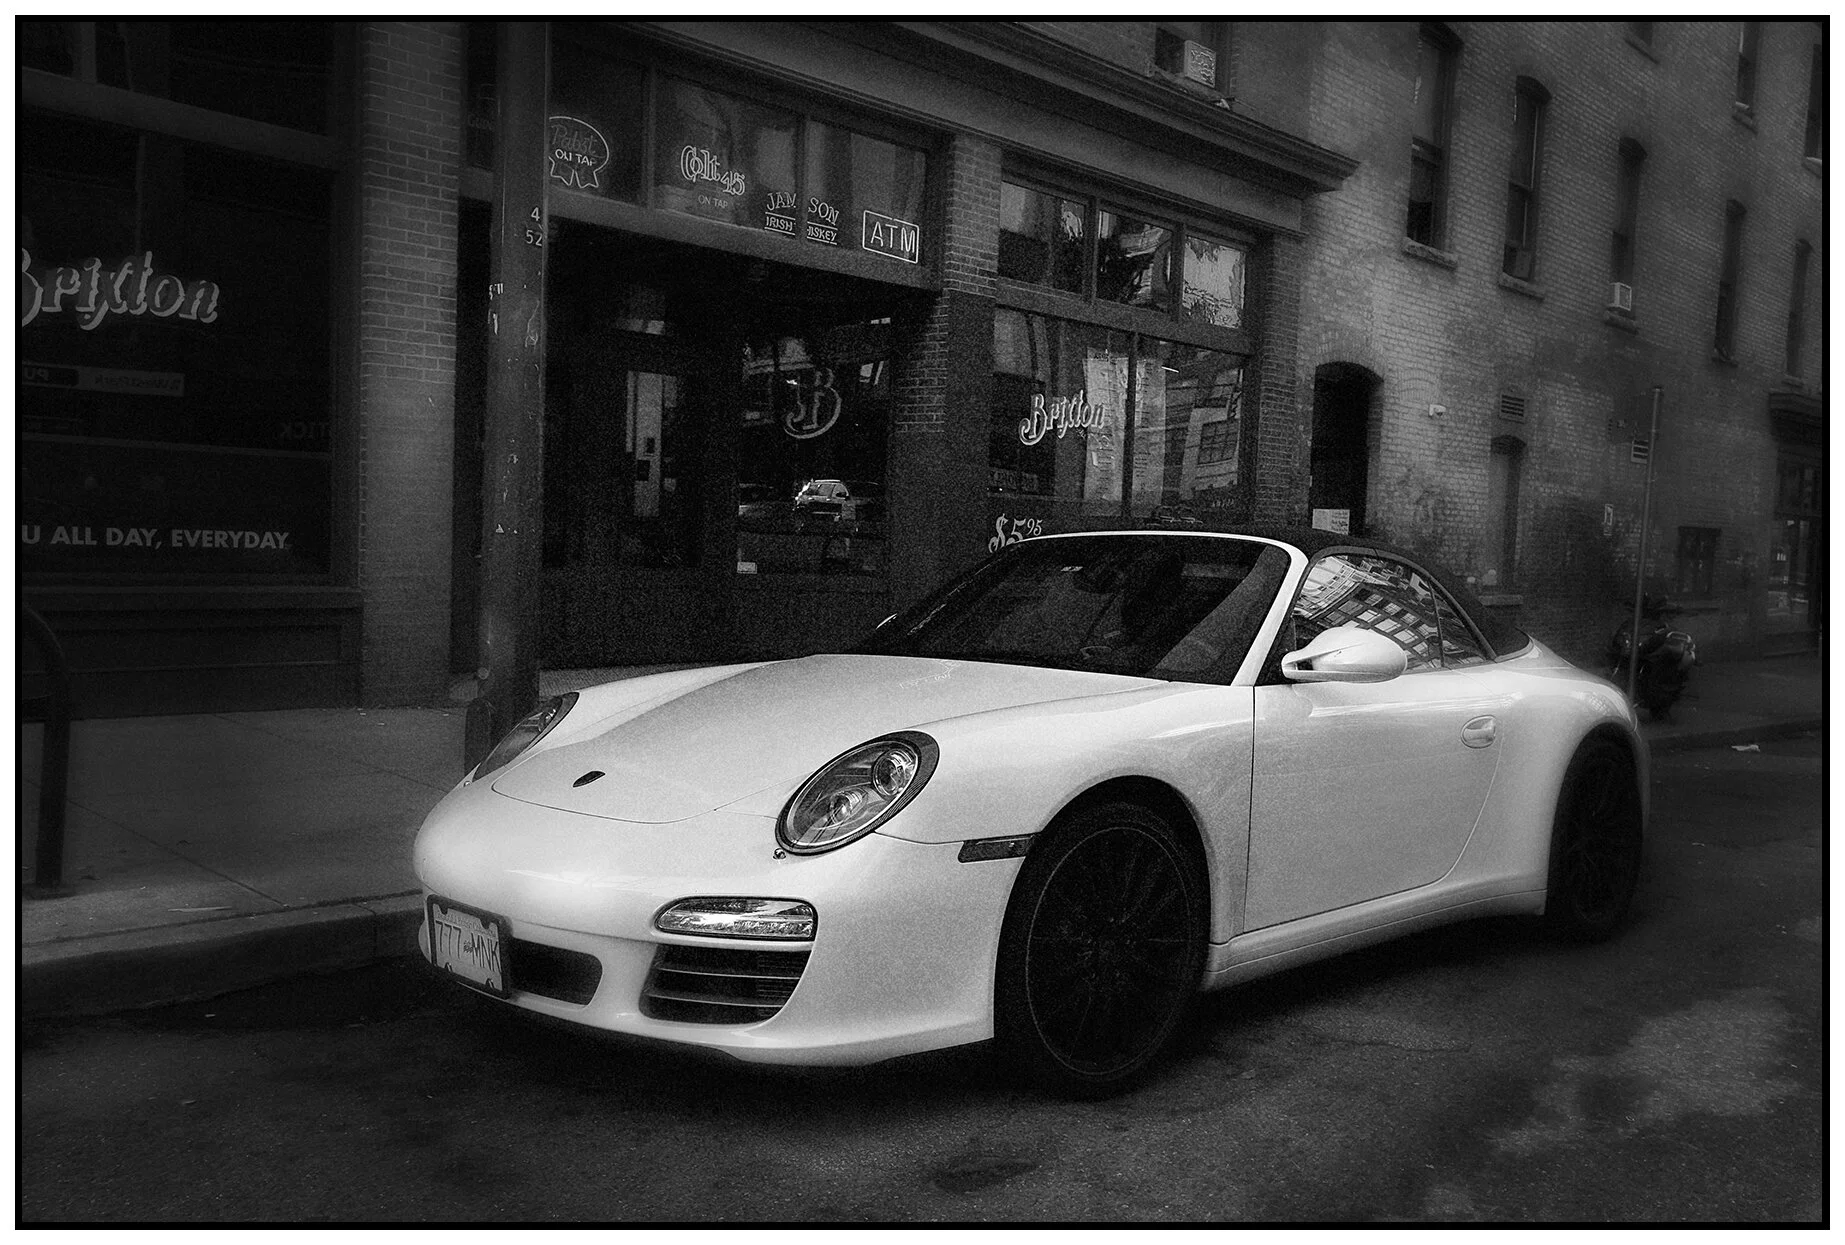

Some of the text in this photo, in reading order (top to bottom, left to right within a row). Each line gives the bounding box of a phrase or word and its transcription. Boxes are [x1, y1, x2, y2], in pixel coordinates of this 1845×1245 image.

[551, 123, 600, 155] Pabst
[555, 149, 598, 167] ON TAP
[680, 145, 746, 196] Colt 45
[530, 206, 541, 222] 4
[697, 194, 729, 209] ON TAP
[766, 191, 840, 227] JAMSON
[525, 229, 544, 248] 52
[766, 216, 837, 244] IRISH ISKEY
[870, 221, 916, 253] ATM
[1019, 388, 1106, 446] Brixton
[51, 526, 98, 546] ALL
[105, 527, 163, 550] DAY,
[171, 529, 290, 550] EVERYDAY
[435, 919, 462, 961] 777
[471, 931, 502, 975] MNK
